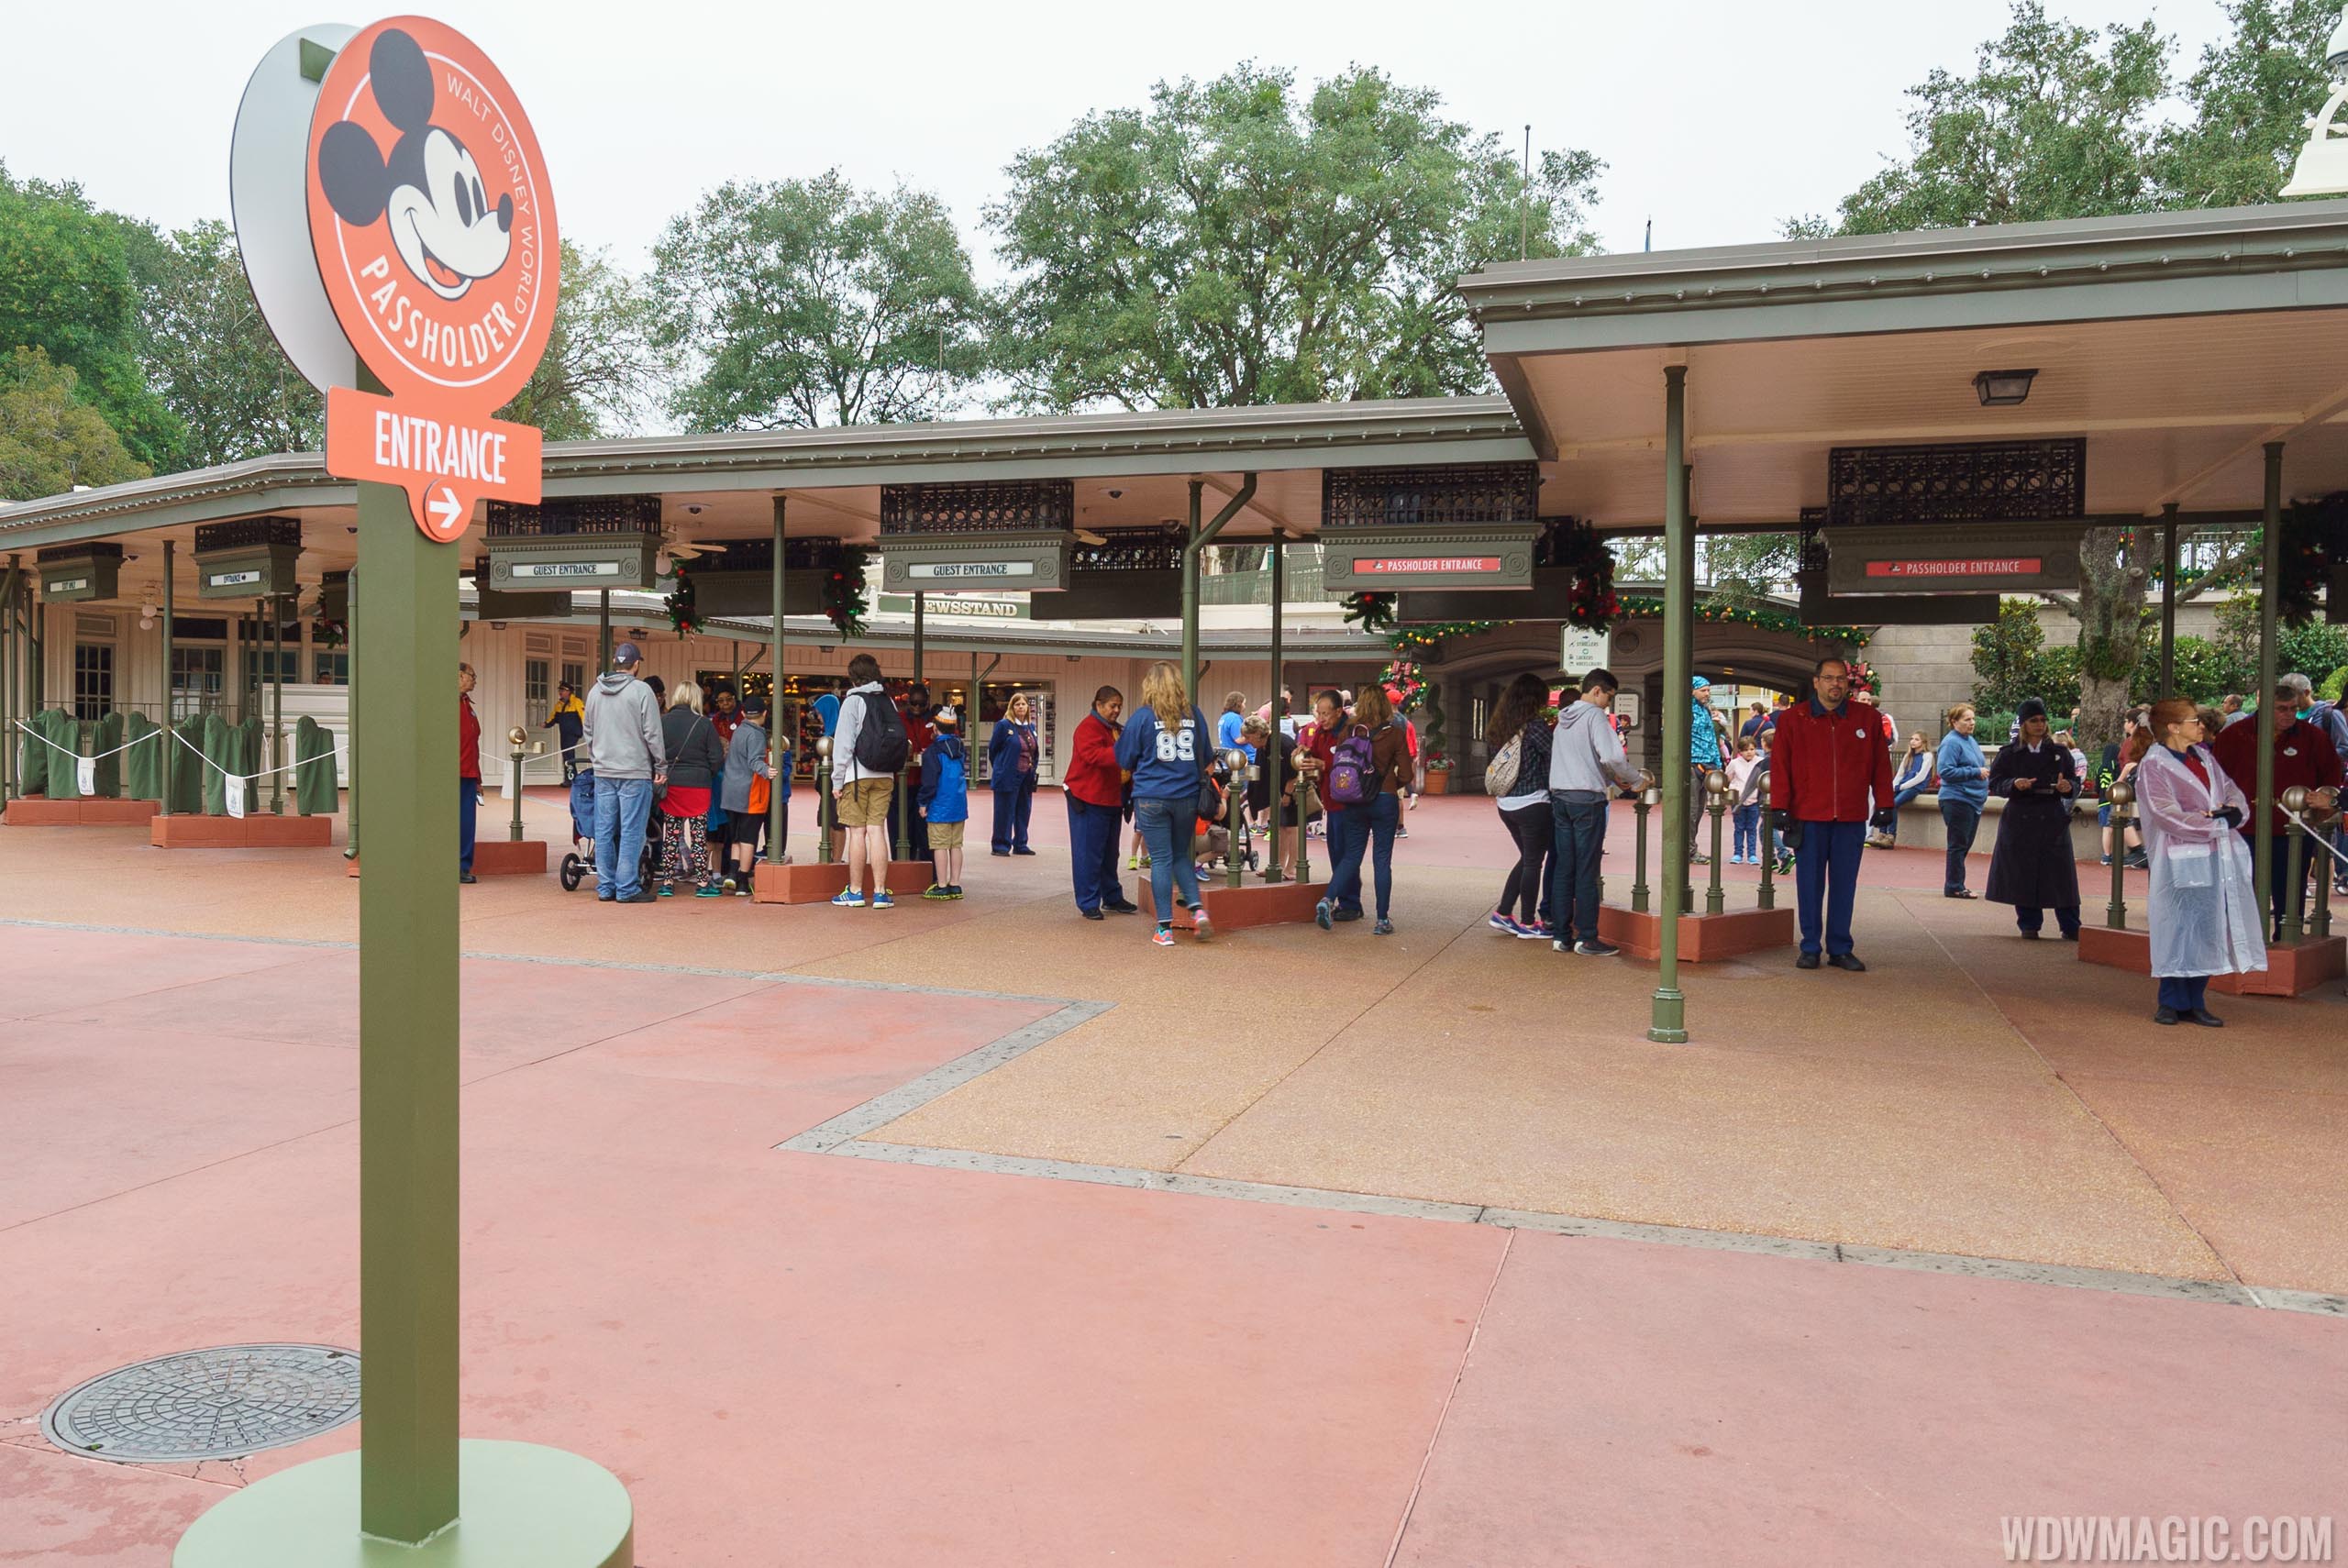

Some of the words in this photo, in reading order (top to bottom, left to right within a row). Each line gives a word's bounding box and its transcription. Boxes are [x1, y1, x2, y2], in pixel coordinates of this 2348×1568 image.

[447, 72, 492, 122] WALT
[491, 123, 532, 215] DISNEY
[514, 226, 533, 315] WORLD
[360, 255, 516, 367] PASSHOLDER
[375, 410, 507, 484] ENTRANCE
[533, 565, 558, 576] GUEST
[559, 564, 597, 575] ENTRANCE
[933, 565, 962, 576] GUEST
[963, 564, 1008, 576] ENTRANCE
[1388, 560, 1439, 571] PASSHOLDER
[1441, 559, 1482, 570] ENTRANCE
[1907, 562, 1966, 574] PASSHOLDER
[1970, 561, 2021, 573] ENTRANCE
[1156, 729, 1195, 762] 89
